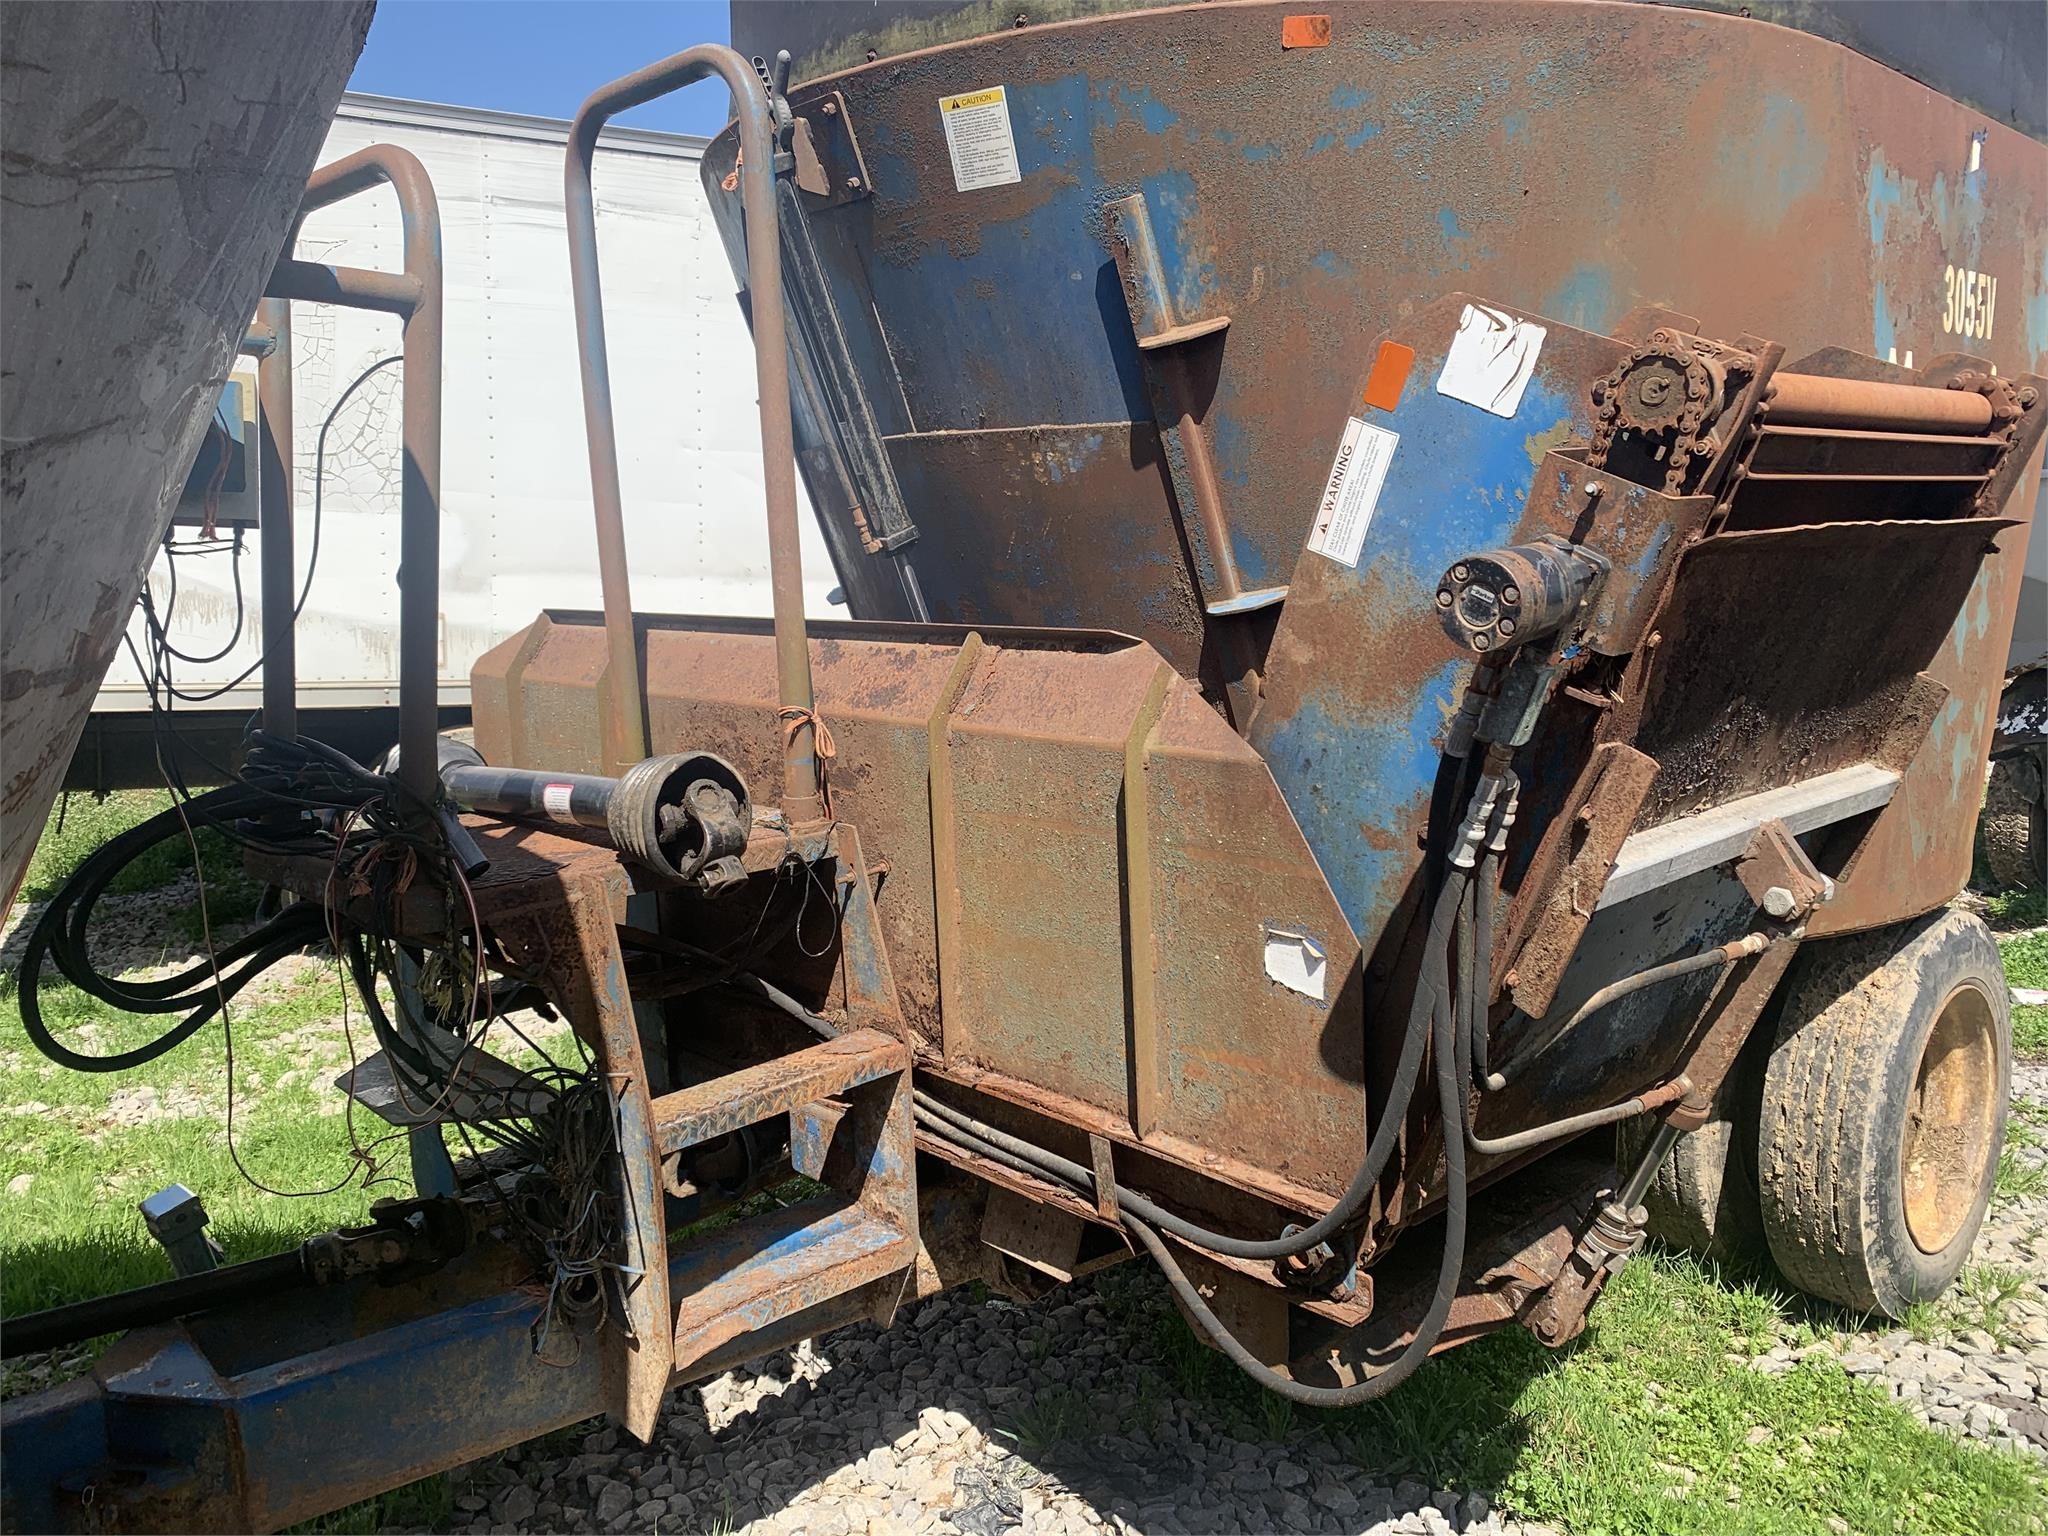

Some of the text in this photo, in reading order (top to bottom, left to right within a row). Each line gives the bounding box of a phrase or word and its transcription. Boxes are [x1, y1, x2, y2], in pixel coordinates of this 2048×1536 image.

[962, 94, 992, 106] CAUTION
[1943, 264, 1998, 340] 3055V
[1324, 445, 1352, 511] WARNING
